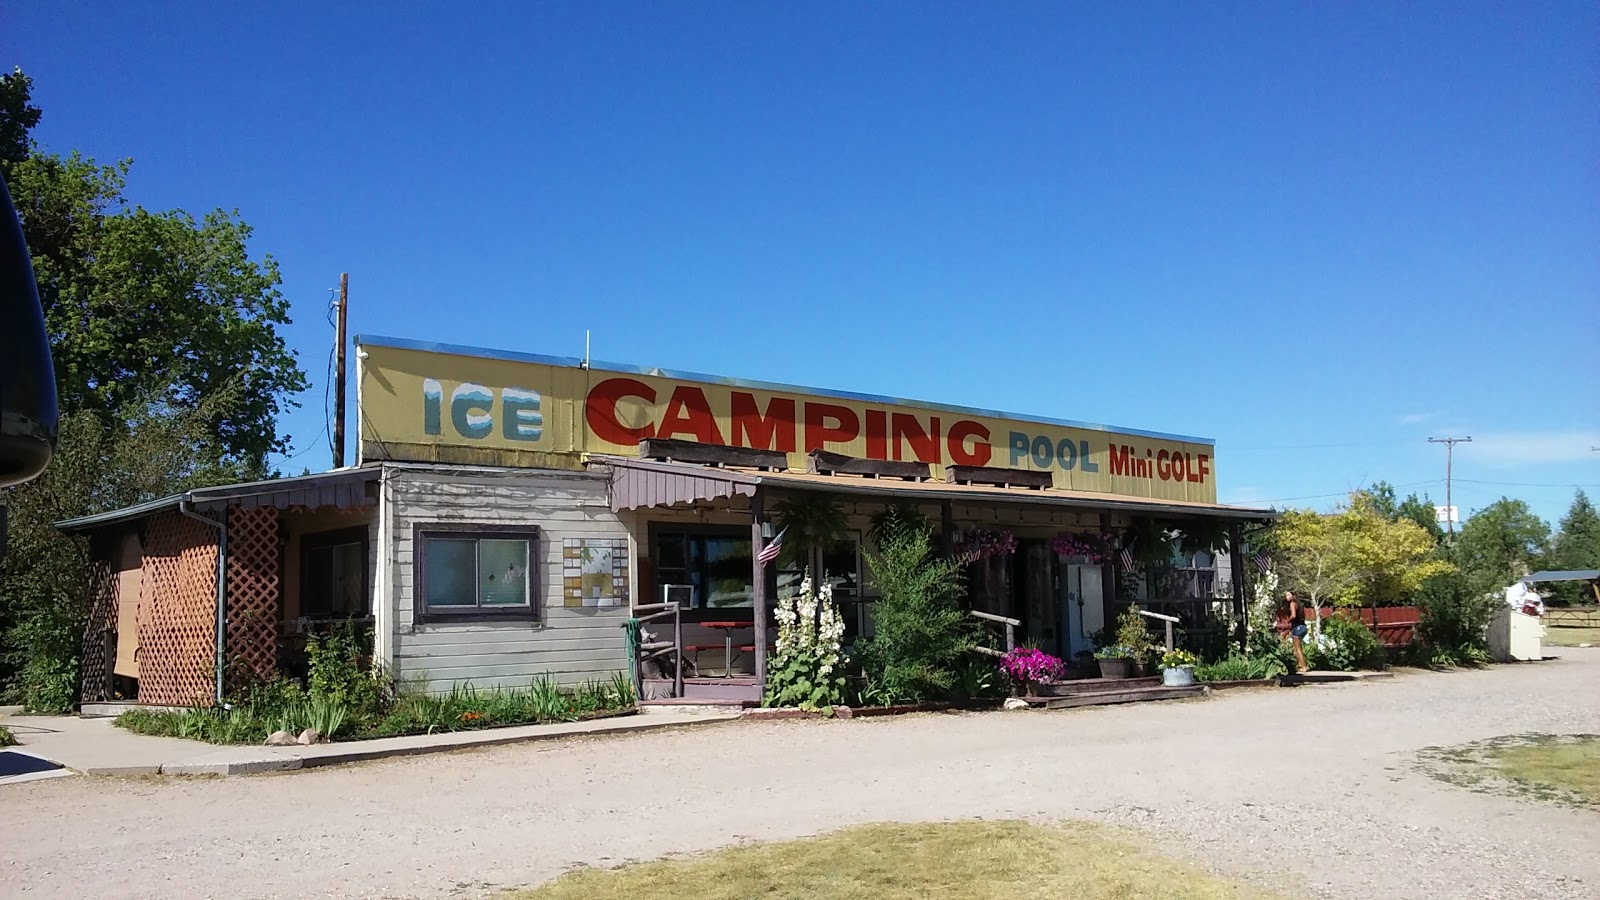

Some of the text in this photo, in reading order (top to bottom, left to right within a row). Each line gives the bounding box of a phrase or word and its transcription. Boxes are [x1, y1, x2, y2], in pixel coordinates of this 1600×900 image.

[423, 378, 1210, 483] ICE CAMPING POOL Mini GOLF
